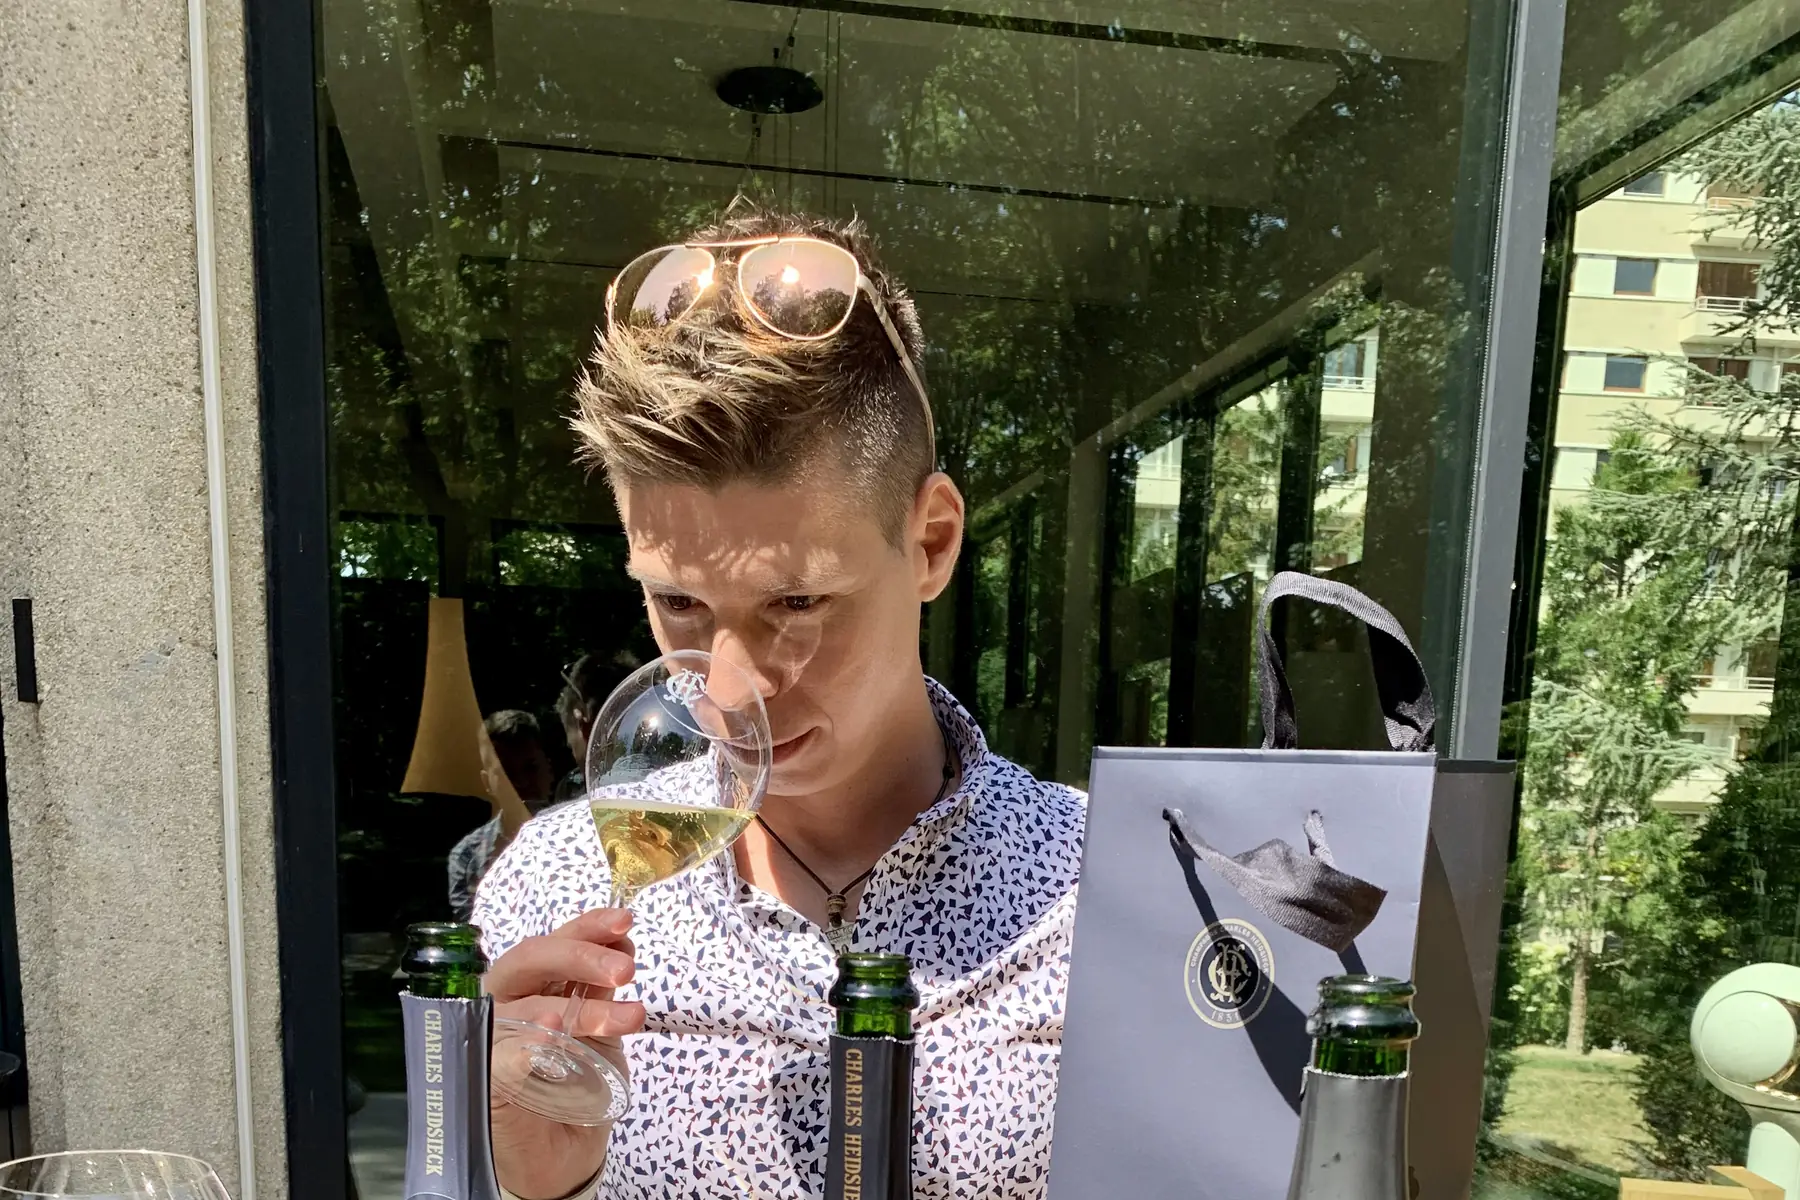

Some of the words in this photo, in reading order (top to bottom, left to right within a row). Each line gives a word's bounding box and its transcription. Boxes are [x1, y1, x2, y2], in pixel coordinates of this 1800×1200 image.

[424, 1009, 443, 1084] CHARLES
[845, 1048, 863, 1128] CHARLES
[425, 1088, 444, 1177] HEIDSIECK
